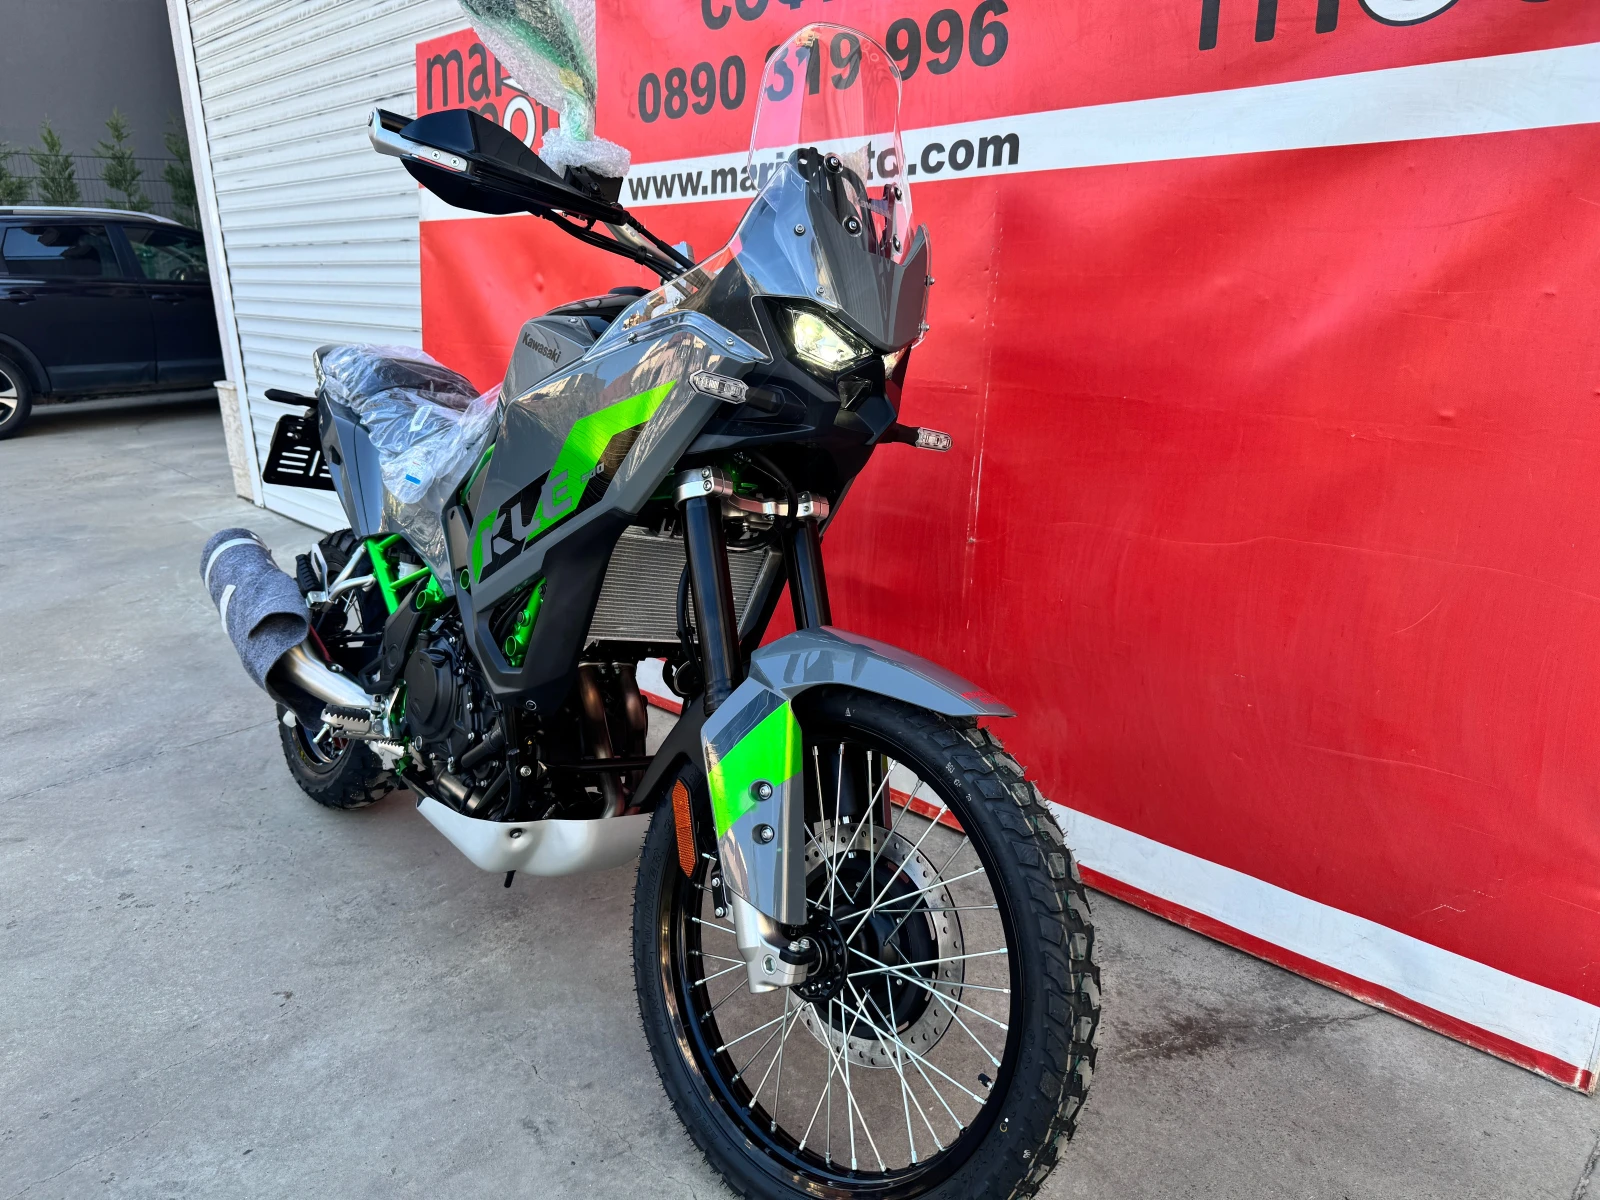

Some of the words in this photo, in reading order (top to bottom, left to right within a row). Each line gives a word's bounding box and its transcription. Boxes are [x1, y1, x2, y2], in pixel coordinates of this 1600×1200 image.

[637, 55, 746, 123] 0890
[765, 32, 861, 102] 319
[886, 0, 1009, 82] 996
[522, 331, 562, 363] Kawasaki
[480, 469, 573, 567] KLE
